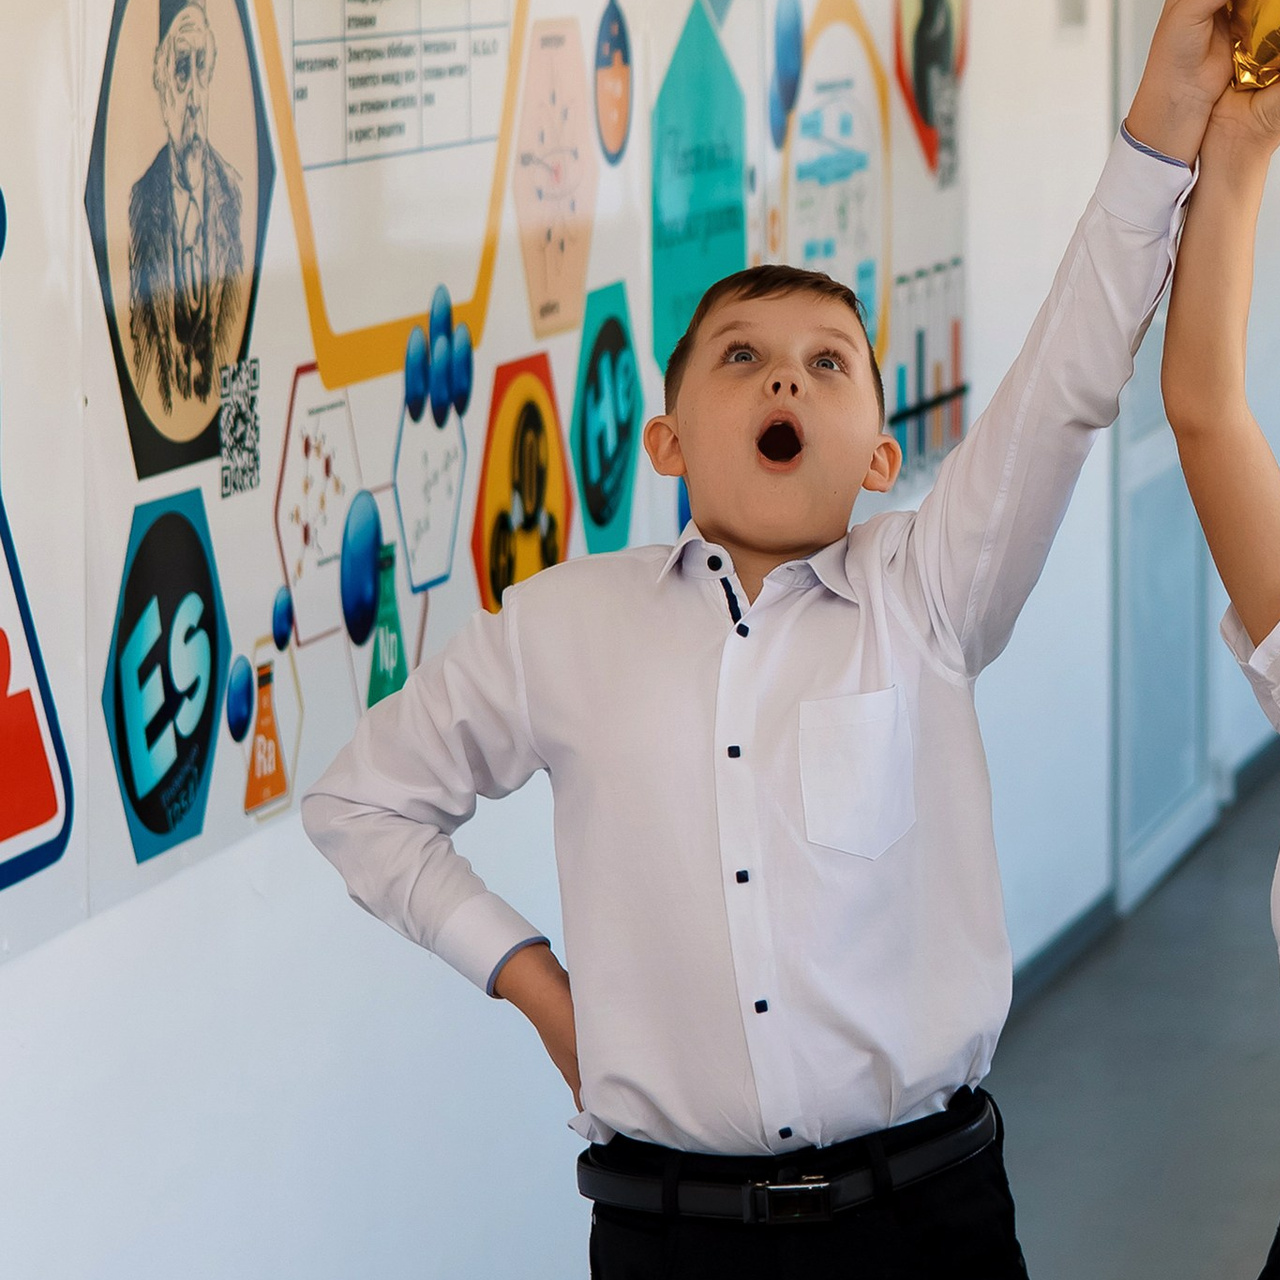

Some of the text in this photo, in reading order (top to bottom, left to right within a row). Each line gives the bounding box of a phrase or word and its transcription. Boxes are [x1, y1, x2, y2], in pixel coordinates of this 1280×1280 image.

[587, 349, 635, 485] He
[119, 590, 213, 801] ES
[379, 624, 398, 680] Np
[254, 734, 277, 779] Ra
